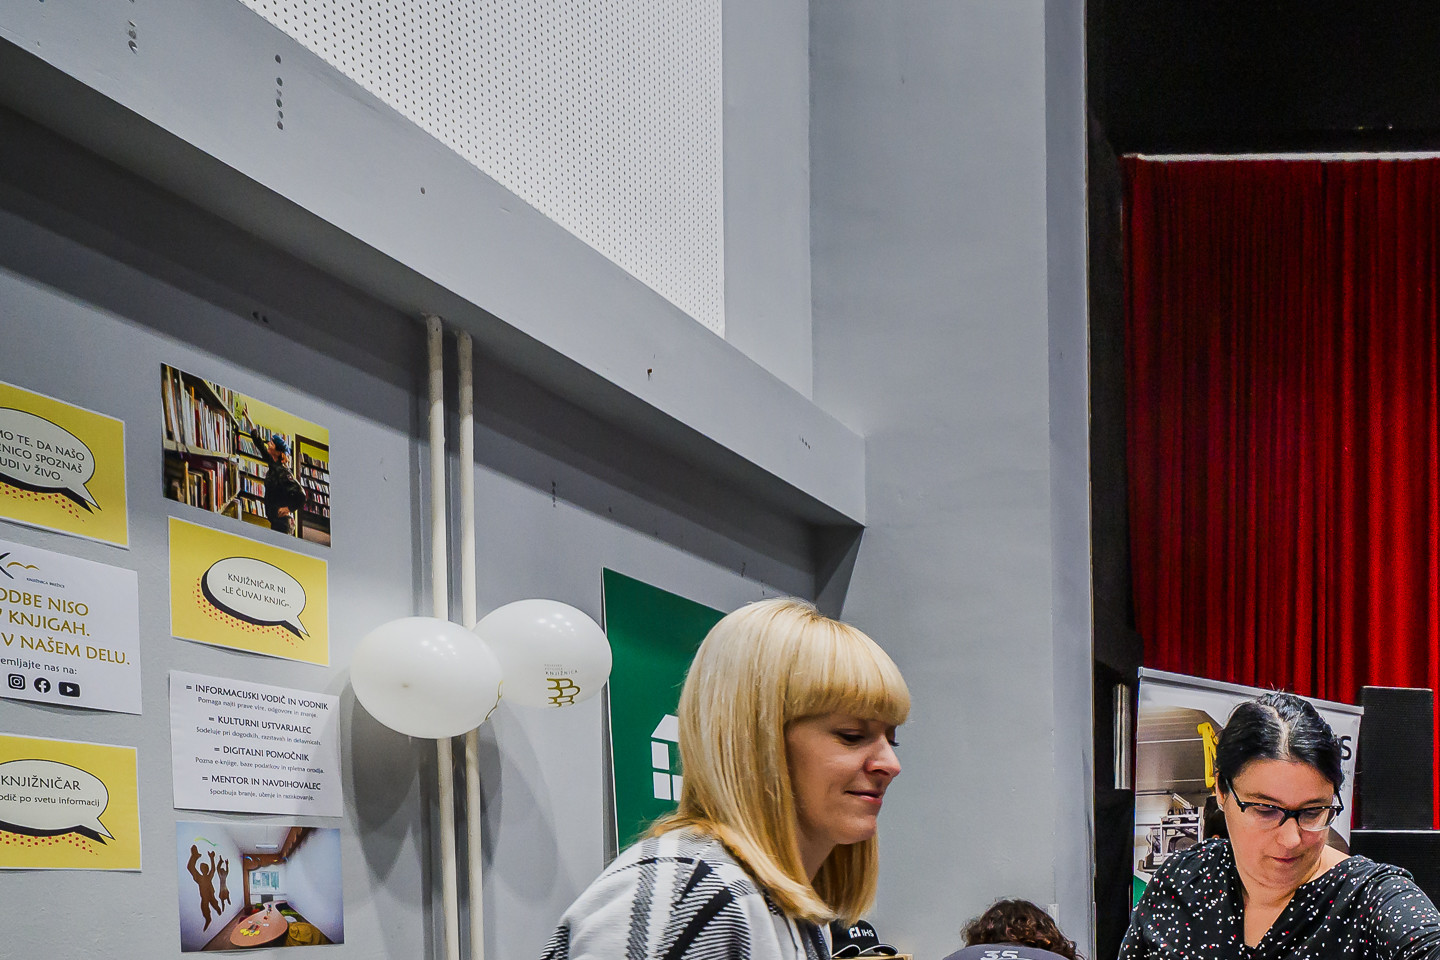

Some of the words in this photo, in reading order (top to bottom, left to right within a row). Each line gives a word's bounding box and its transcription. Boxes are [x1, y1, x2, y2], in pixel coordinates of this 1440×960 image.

[0, 443, 32, 459] NICO
[36, 453, 82, 473] SPOZNAŠ
[37, 440, 52, 452] DA
[56, 446, 84, 461] NAŠO
[23, 463, 31, 472] V
[34, 463, 64, 481] ŽIVO.
[227, 573, 275, 591] KNJIŽNIČAR
[277, 586, 286, 594] NI
[236, 587, 262, 601] ČUVAJ
[48, 597, 89, 617] NISO
[8, 609, 91, 637] KNJIGAH.
[1, 633, 14, 647] V
[20, 636, 81, 658] NAŠEM
[86, 645, 130, 665] DELU.
[44, 663, 60, 673] nas
[62, 666, 78, 675] na:
[195, 684, 259, 701] INFORMACIJSKI
[260, 692, 286, 705] VODIČ
[288, 698, 297, 706] IN
[298, 699, 329, 711] VODNIK
[197, 696, 222, 706] Pomaga
[217, 715, 260, 728] KULTURNI
[261, 721, 312, 735] USTVARJALEC
[223, 745, 264, 757] DIGITALNI
[266, 750, 310, 761] POMOČNIK
[1, 774, 81, 791] KNJIŽNIČAR
[211, 775, 249, 786] MENTOR
[251, 778, 260, 786] IN
[262, 779, 322, 791] NAVDIHOVALEC
[34, 796, 56, 804] svetu
[58, 797, 100, 807] informacij
[861, 928, 875, 938] IHS
